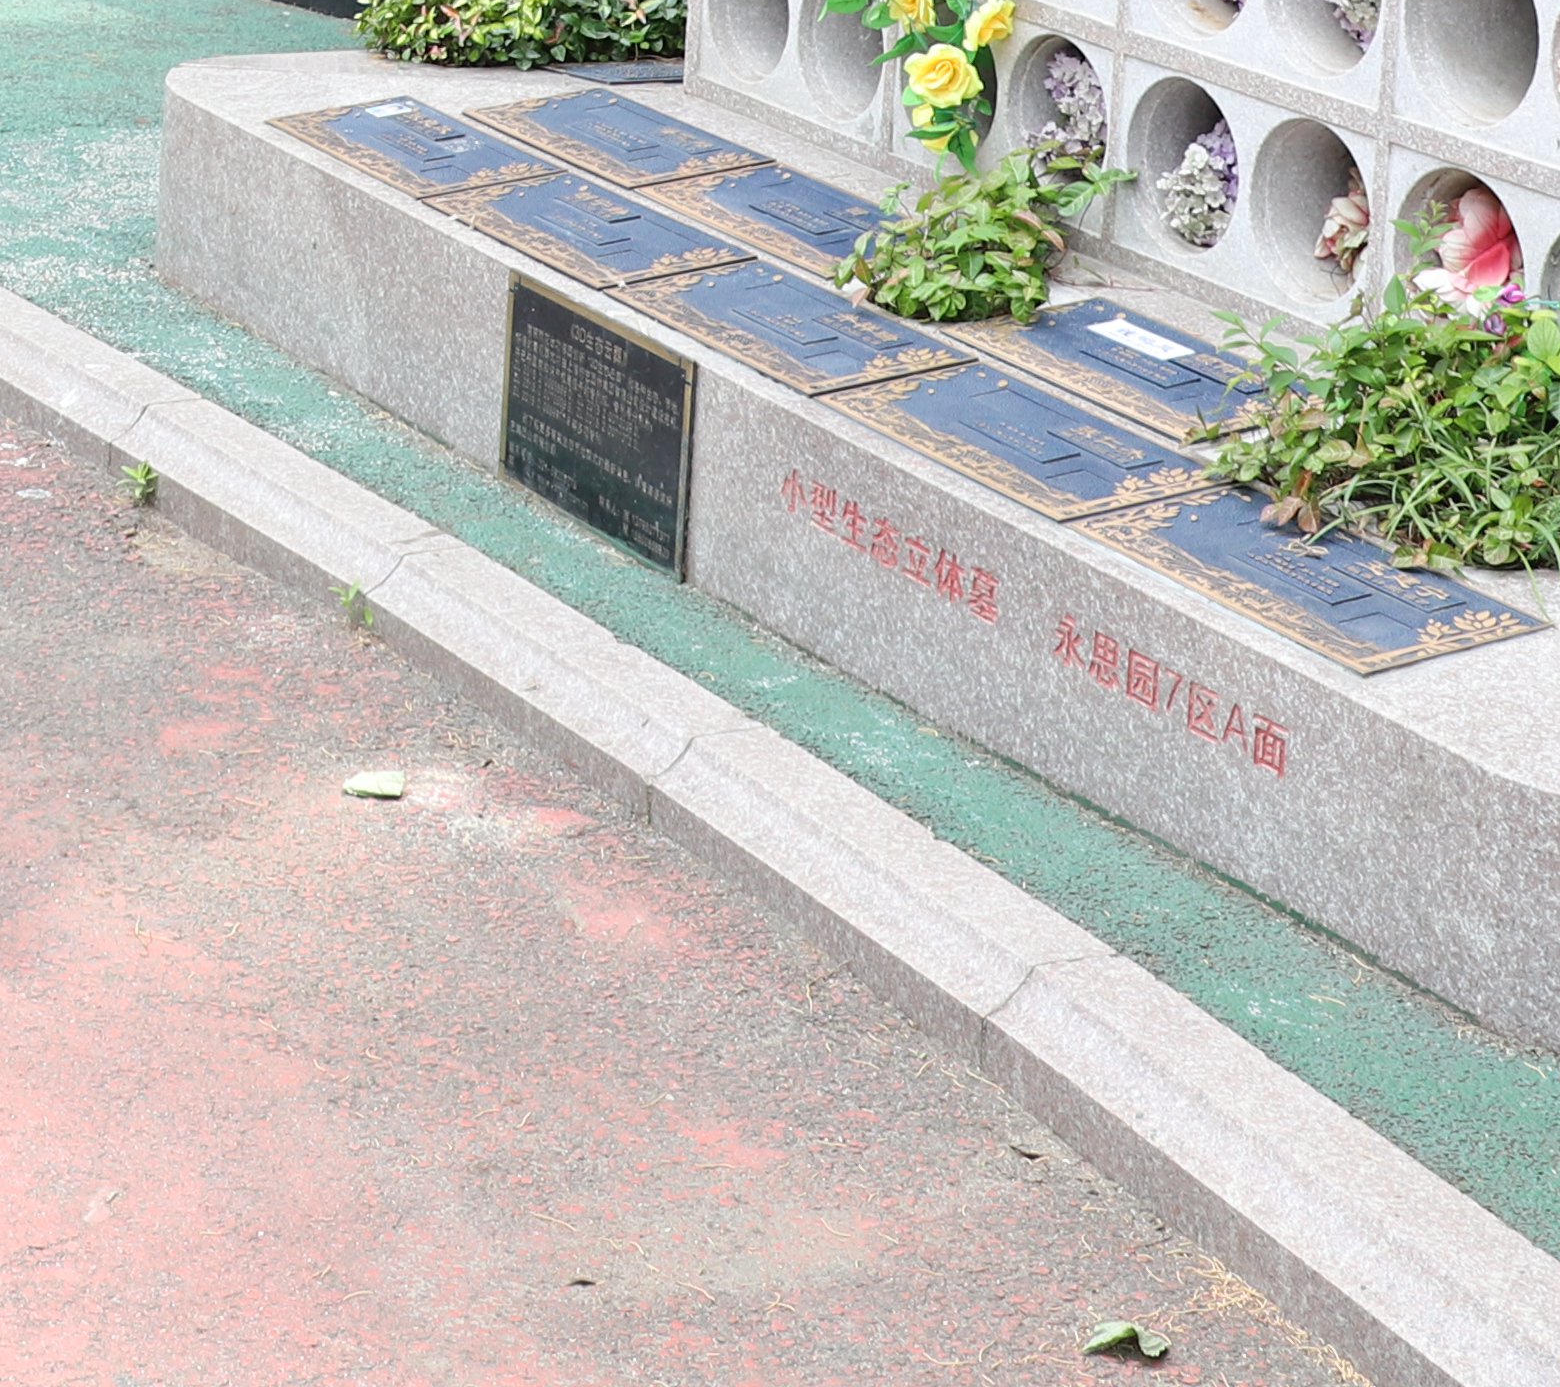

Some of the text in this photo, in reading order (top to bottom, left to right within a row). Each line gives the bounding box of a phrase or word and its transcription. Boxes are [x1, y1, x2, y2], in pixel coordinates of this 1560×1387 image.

[780, 467, 1290, 779] 小型生态立体墓 永思园7区A面
